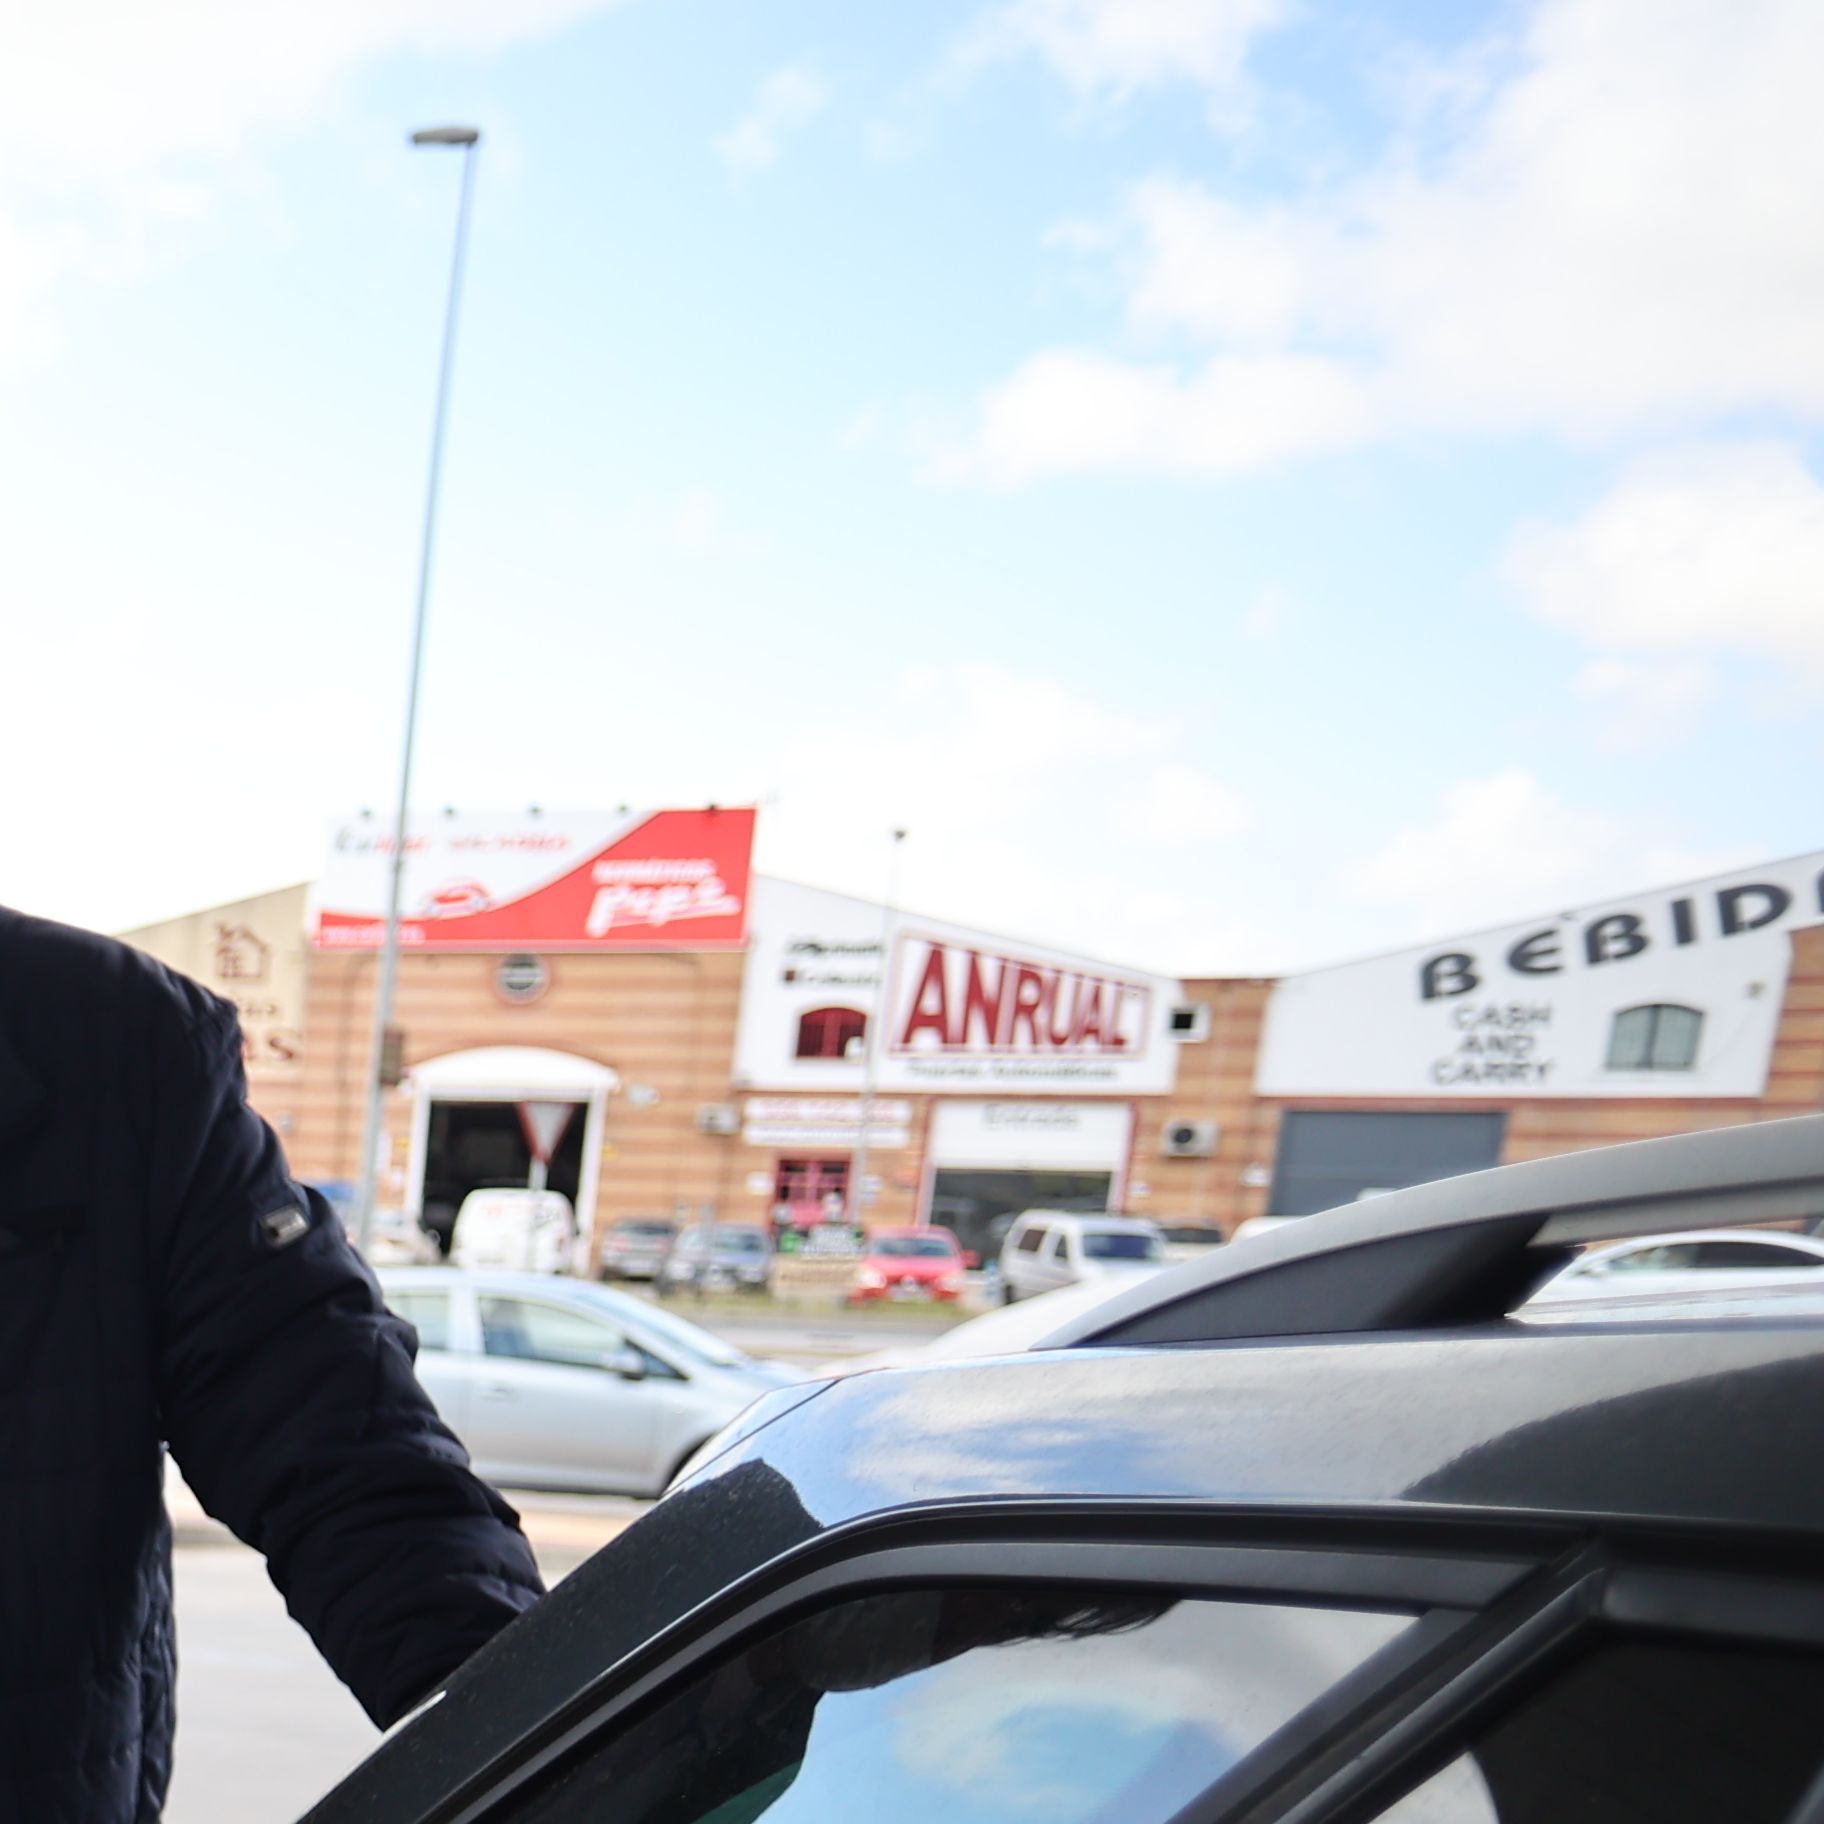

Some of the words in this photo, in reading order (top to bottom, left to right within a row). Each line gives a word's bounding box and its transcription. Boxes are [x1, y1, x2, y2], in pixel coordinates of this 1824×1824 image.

[1420, 868, 1824, 1003] BEBID
[902, 940, 1128, 1046] ANRUAL
[1453, 1003, 1553, 1031] CASH
[1458, 1034, 1535, 1059] AND
[1434, 1058, 1554, 1086] CARRY
